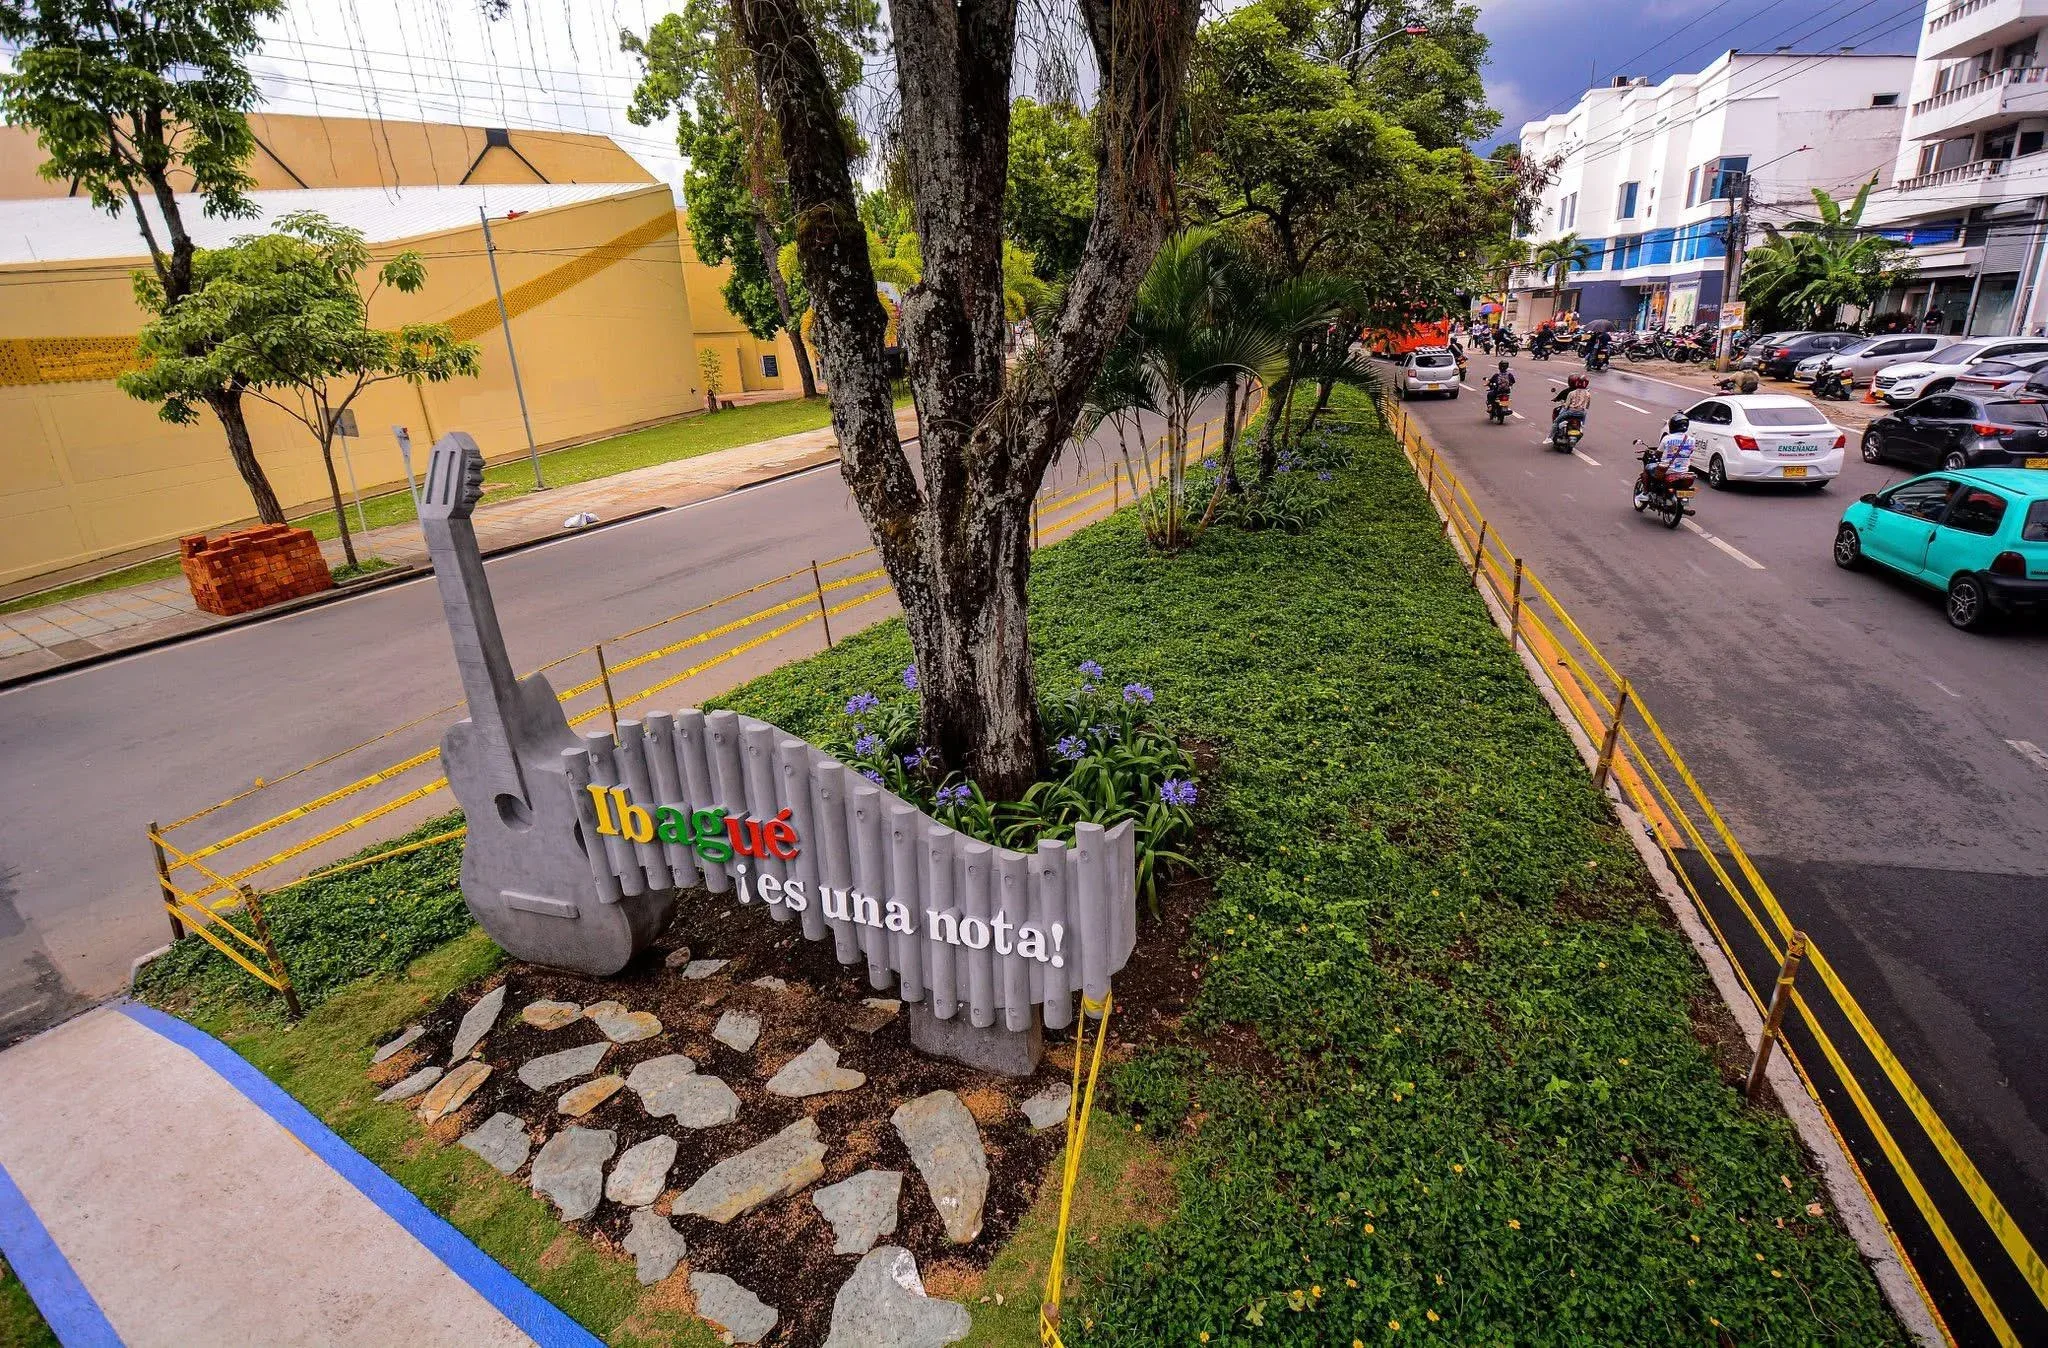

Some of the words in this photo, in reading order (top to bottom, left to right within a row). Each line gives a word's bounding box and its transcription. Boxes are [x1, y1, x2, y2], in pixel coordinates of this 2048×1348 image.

[586, 783, 799, 862] Ibagué
[819, 883, 914, 935] una
[926, 907, 1065, 969] nota!
